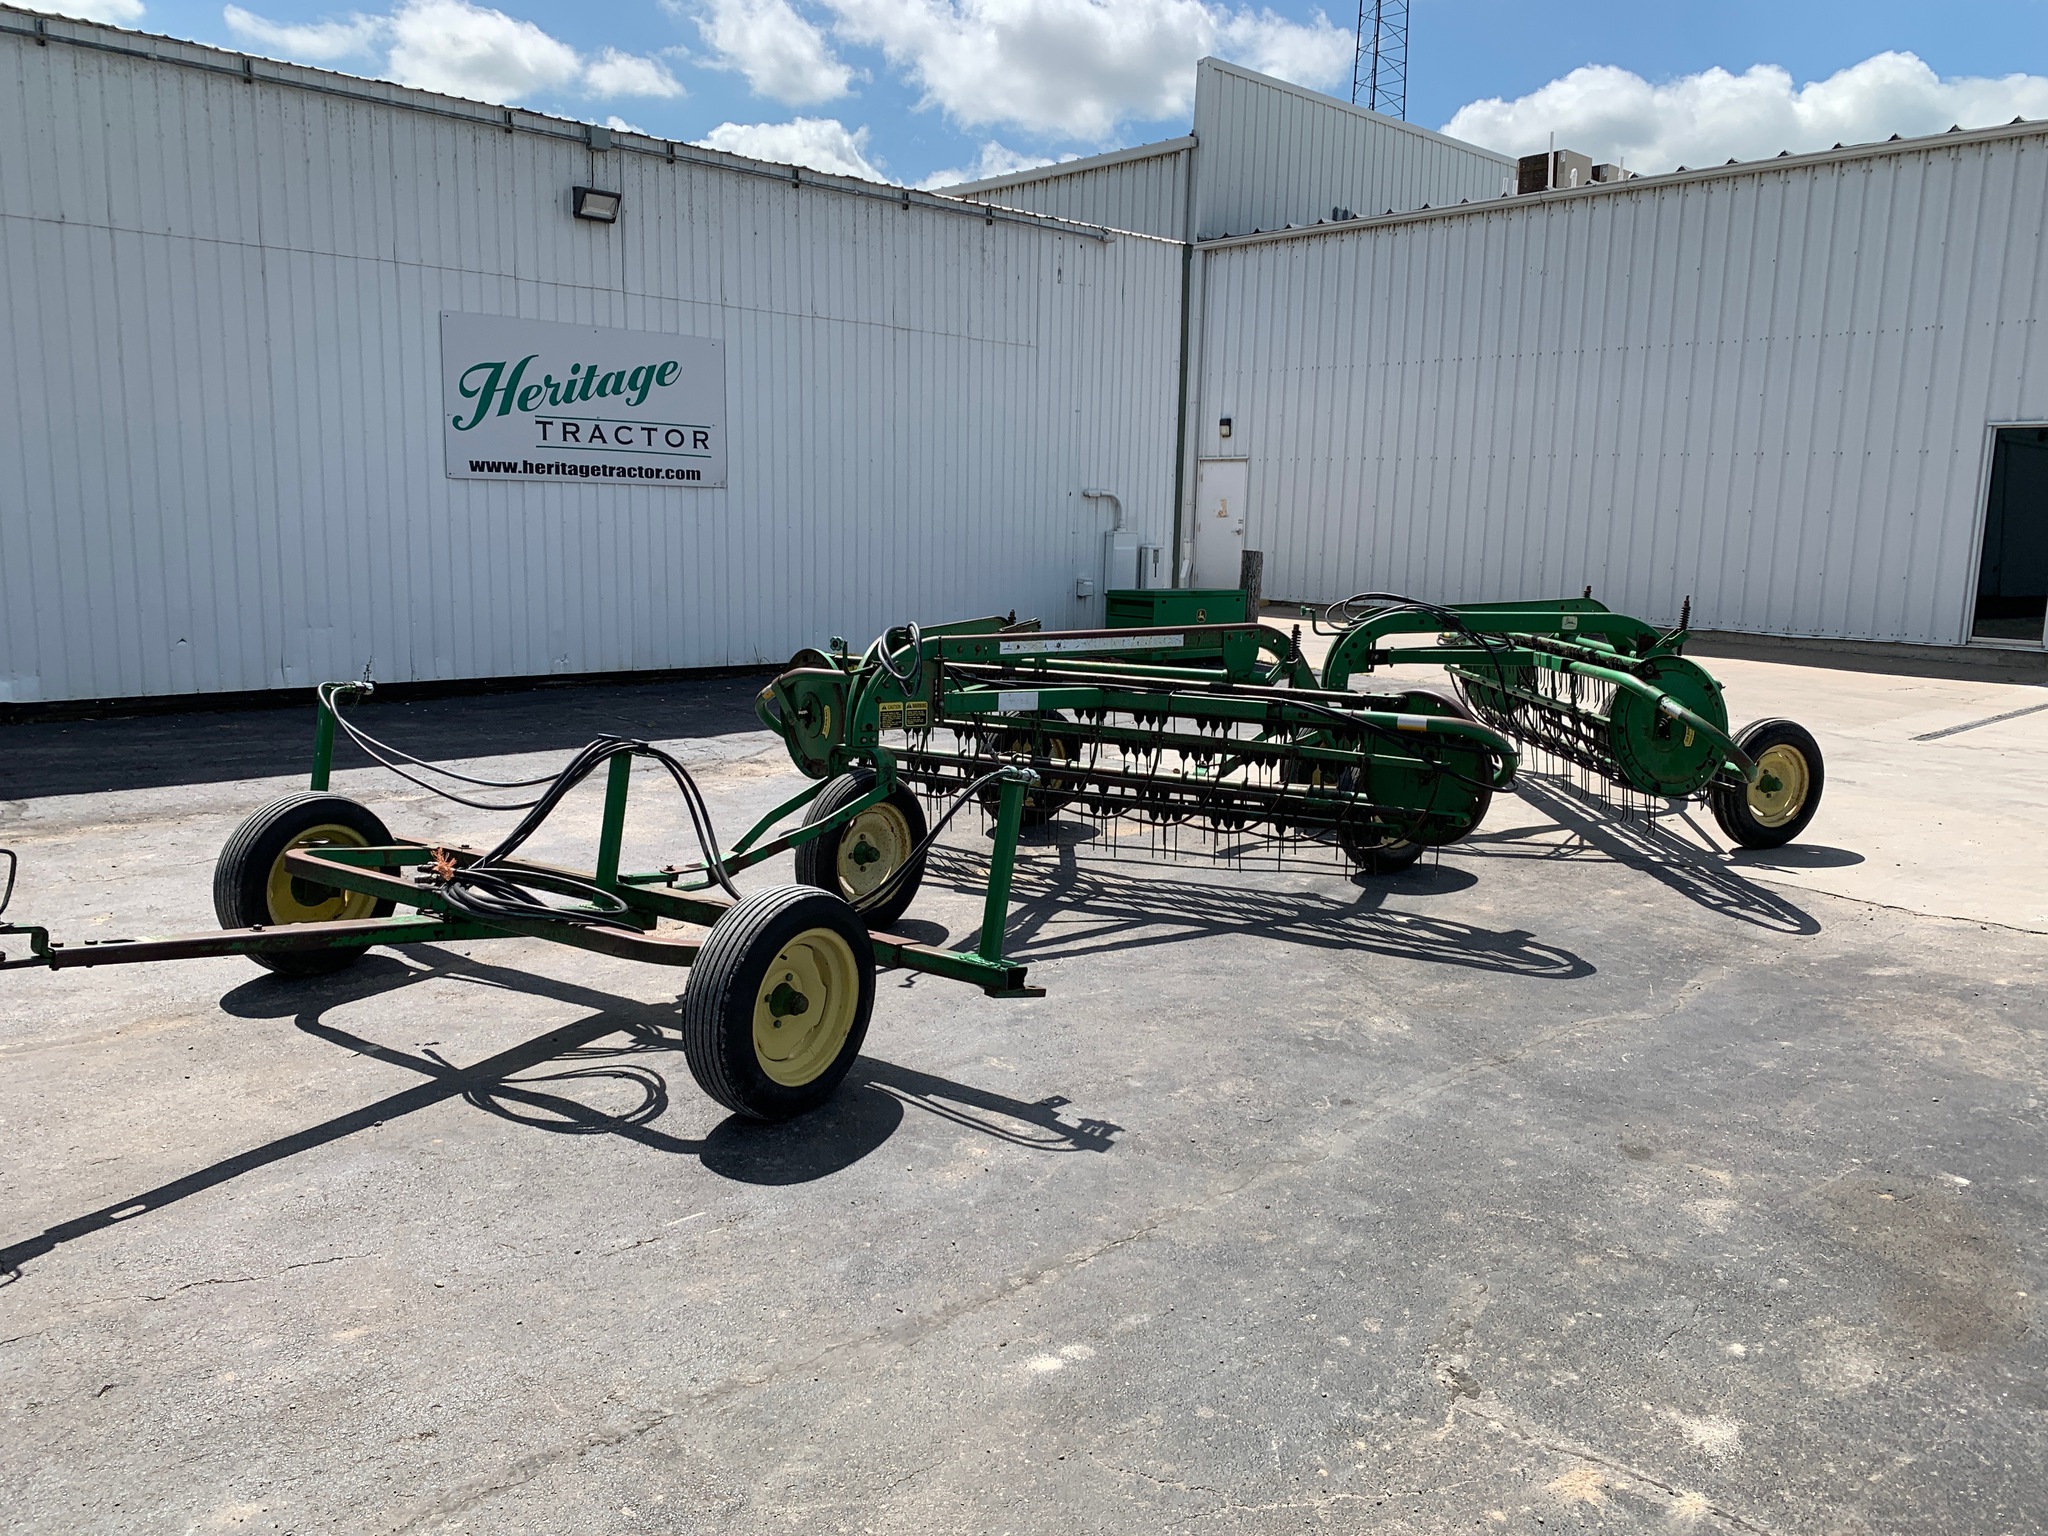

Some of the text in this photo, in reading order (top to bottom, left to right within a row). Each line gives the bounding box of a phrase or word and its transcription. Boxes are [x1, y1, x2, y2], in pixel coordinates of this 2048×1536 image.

[452, 354, 682, 431] Heritage
[534, 419, 711, 450] TRACTOR
[468, 458, 701, 481] www.heritagetractor.com
